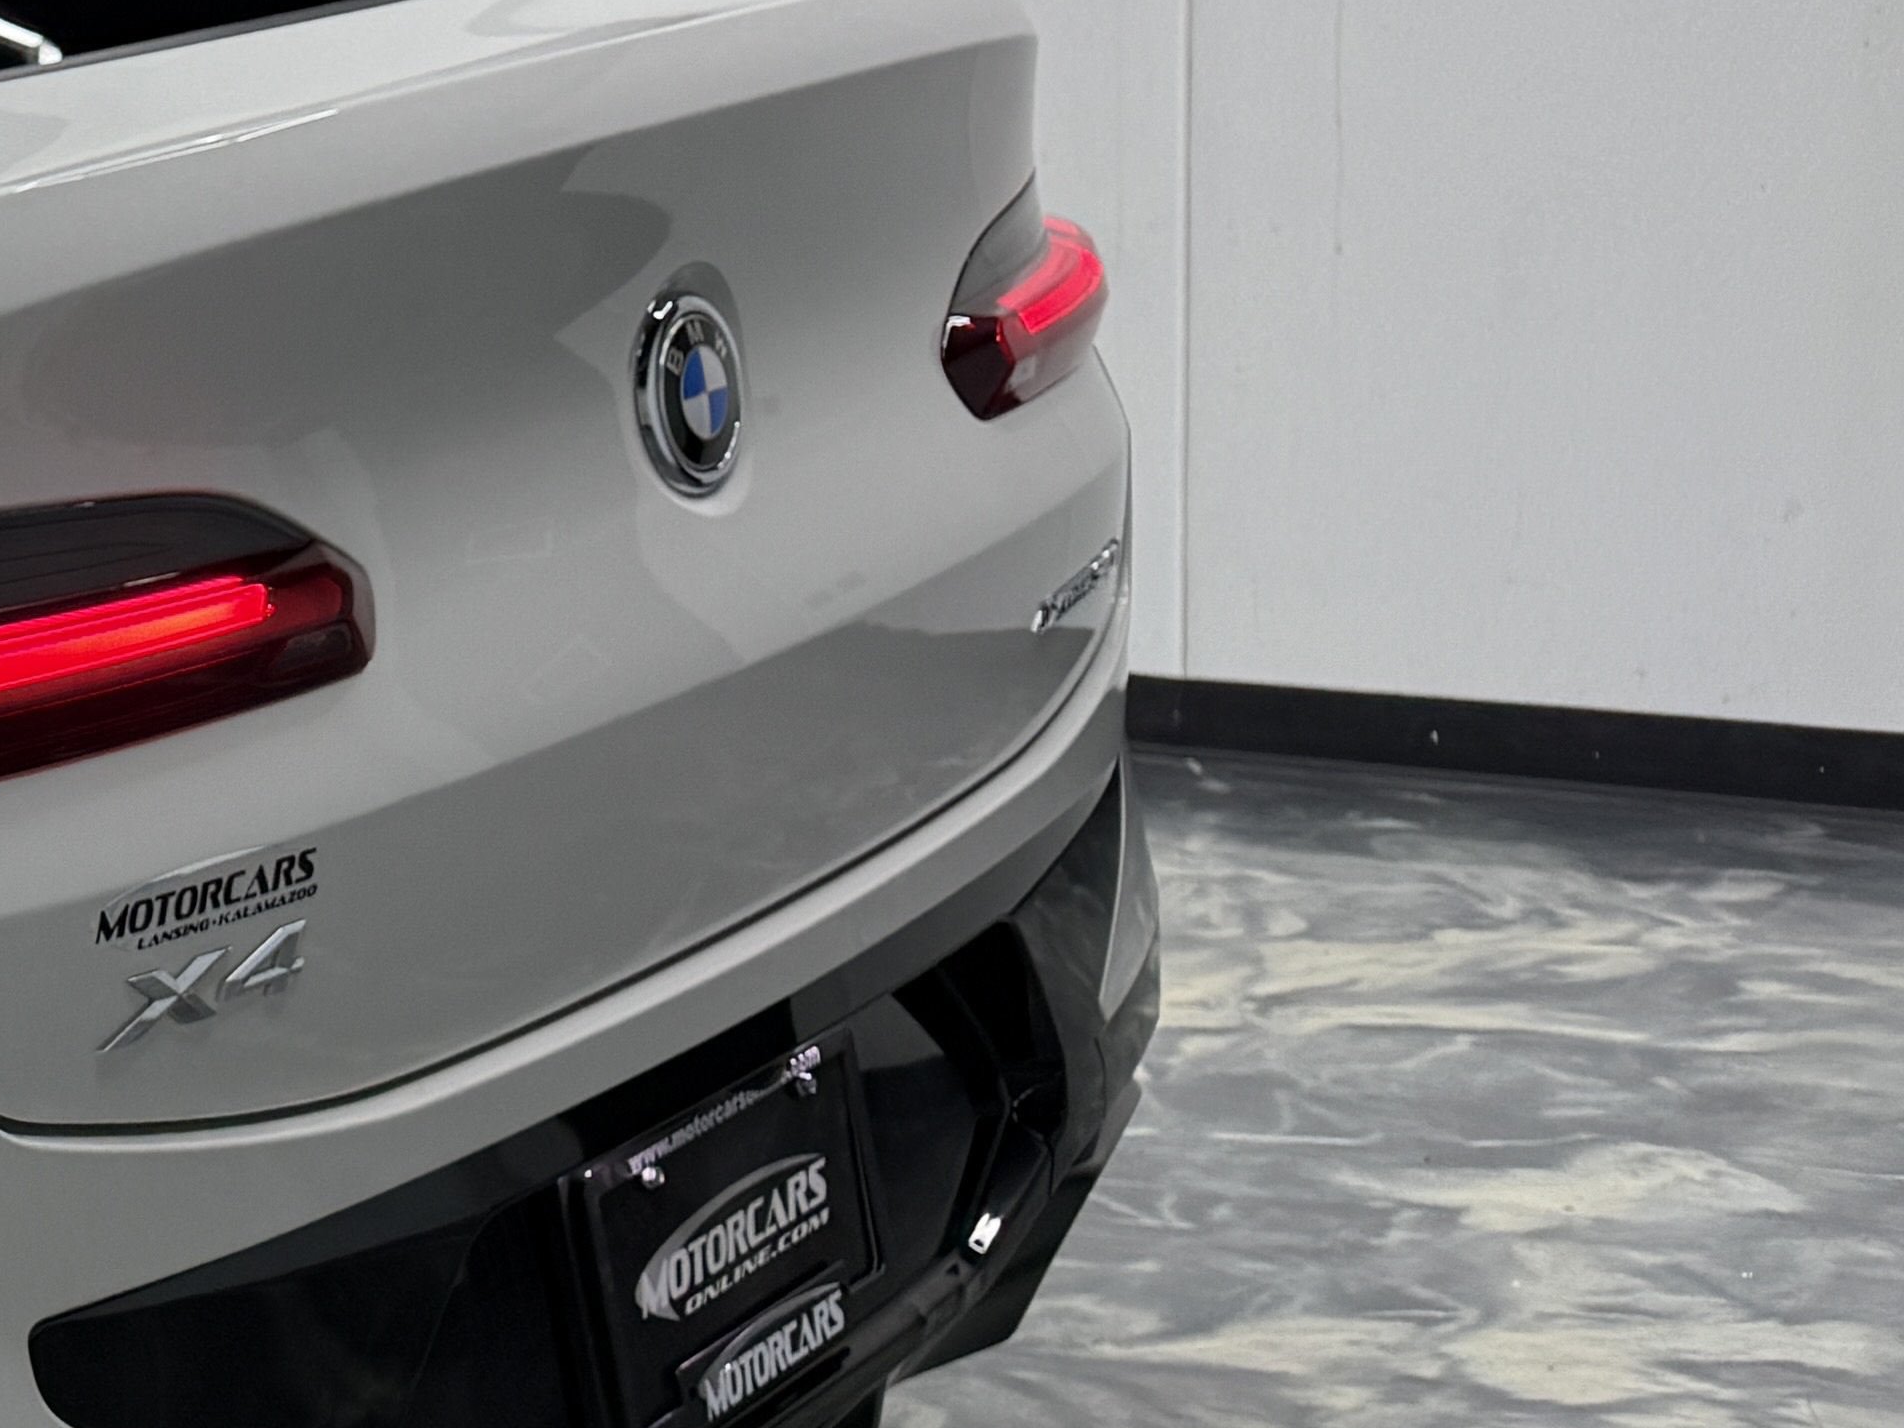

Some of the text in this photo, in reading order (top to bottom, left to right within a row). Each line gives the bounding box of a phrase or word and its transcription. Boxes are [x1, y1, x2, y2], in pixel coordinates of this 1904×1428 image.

[95, 847, 317, 945] MOTORCARS
[95, 918, 308, 1053] X4
[639, 1156, 828, 1322] MOTORCARS
[684, 1206, 830, 1317] ONLINE.COM
[702, 1287, 846, 1423] MOTORCARS
